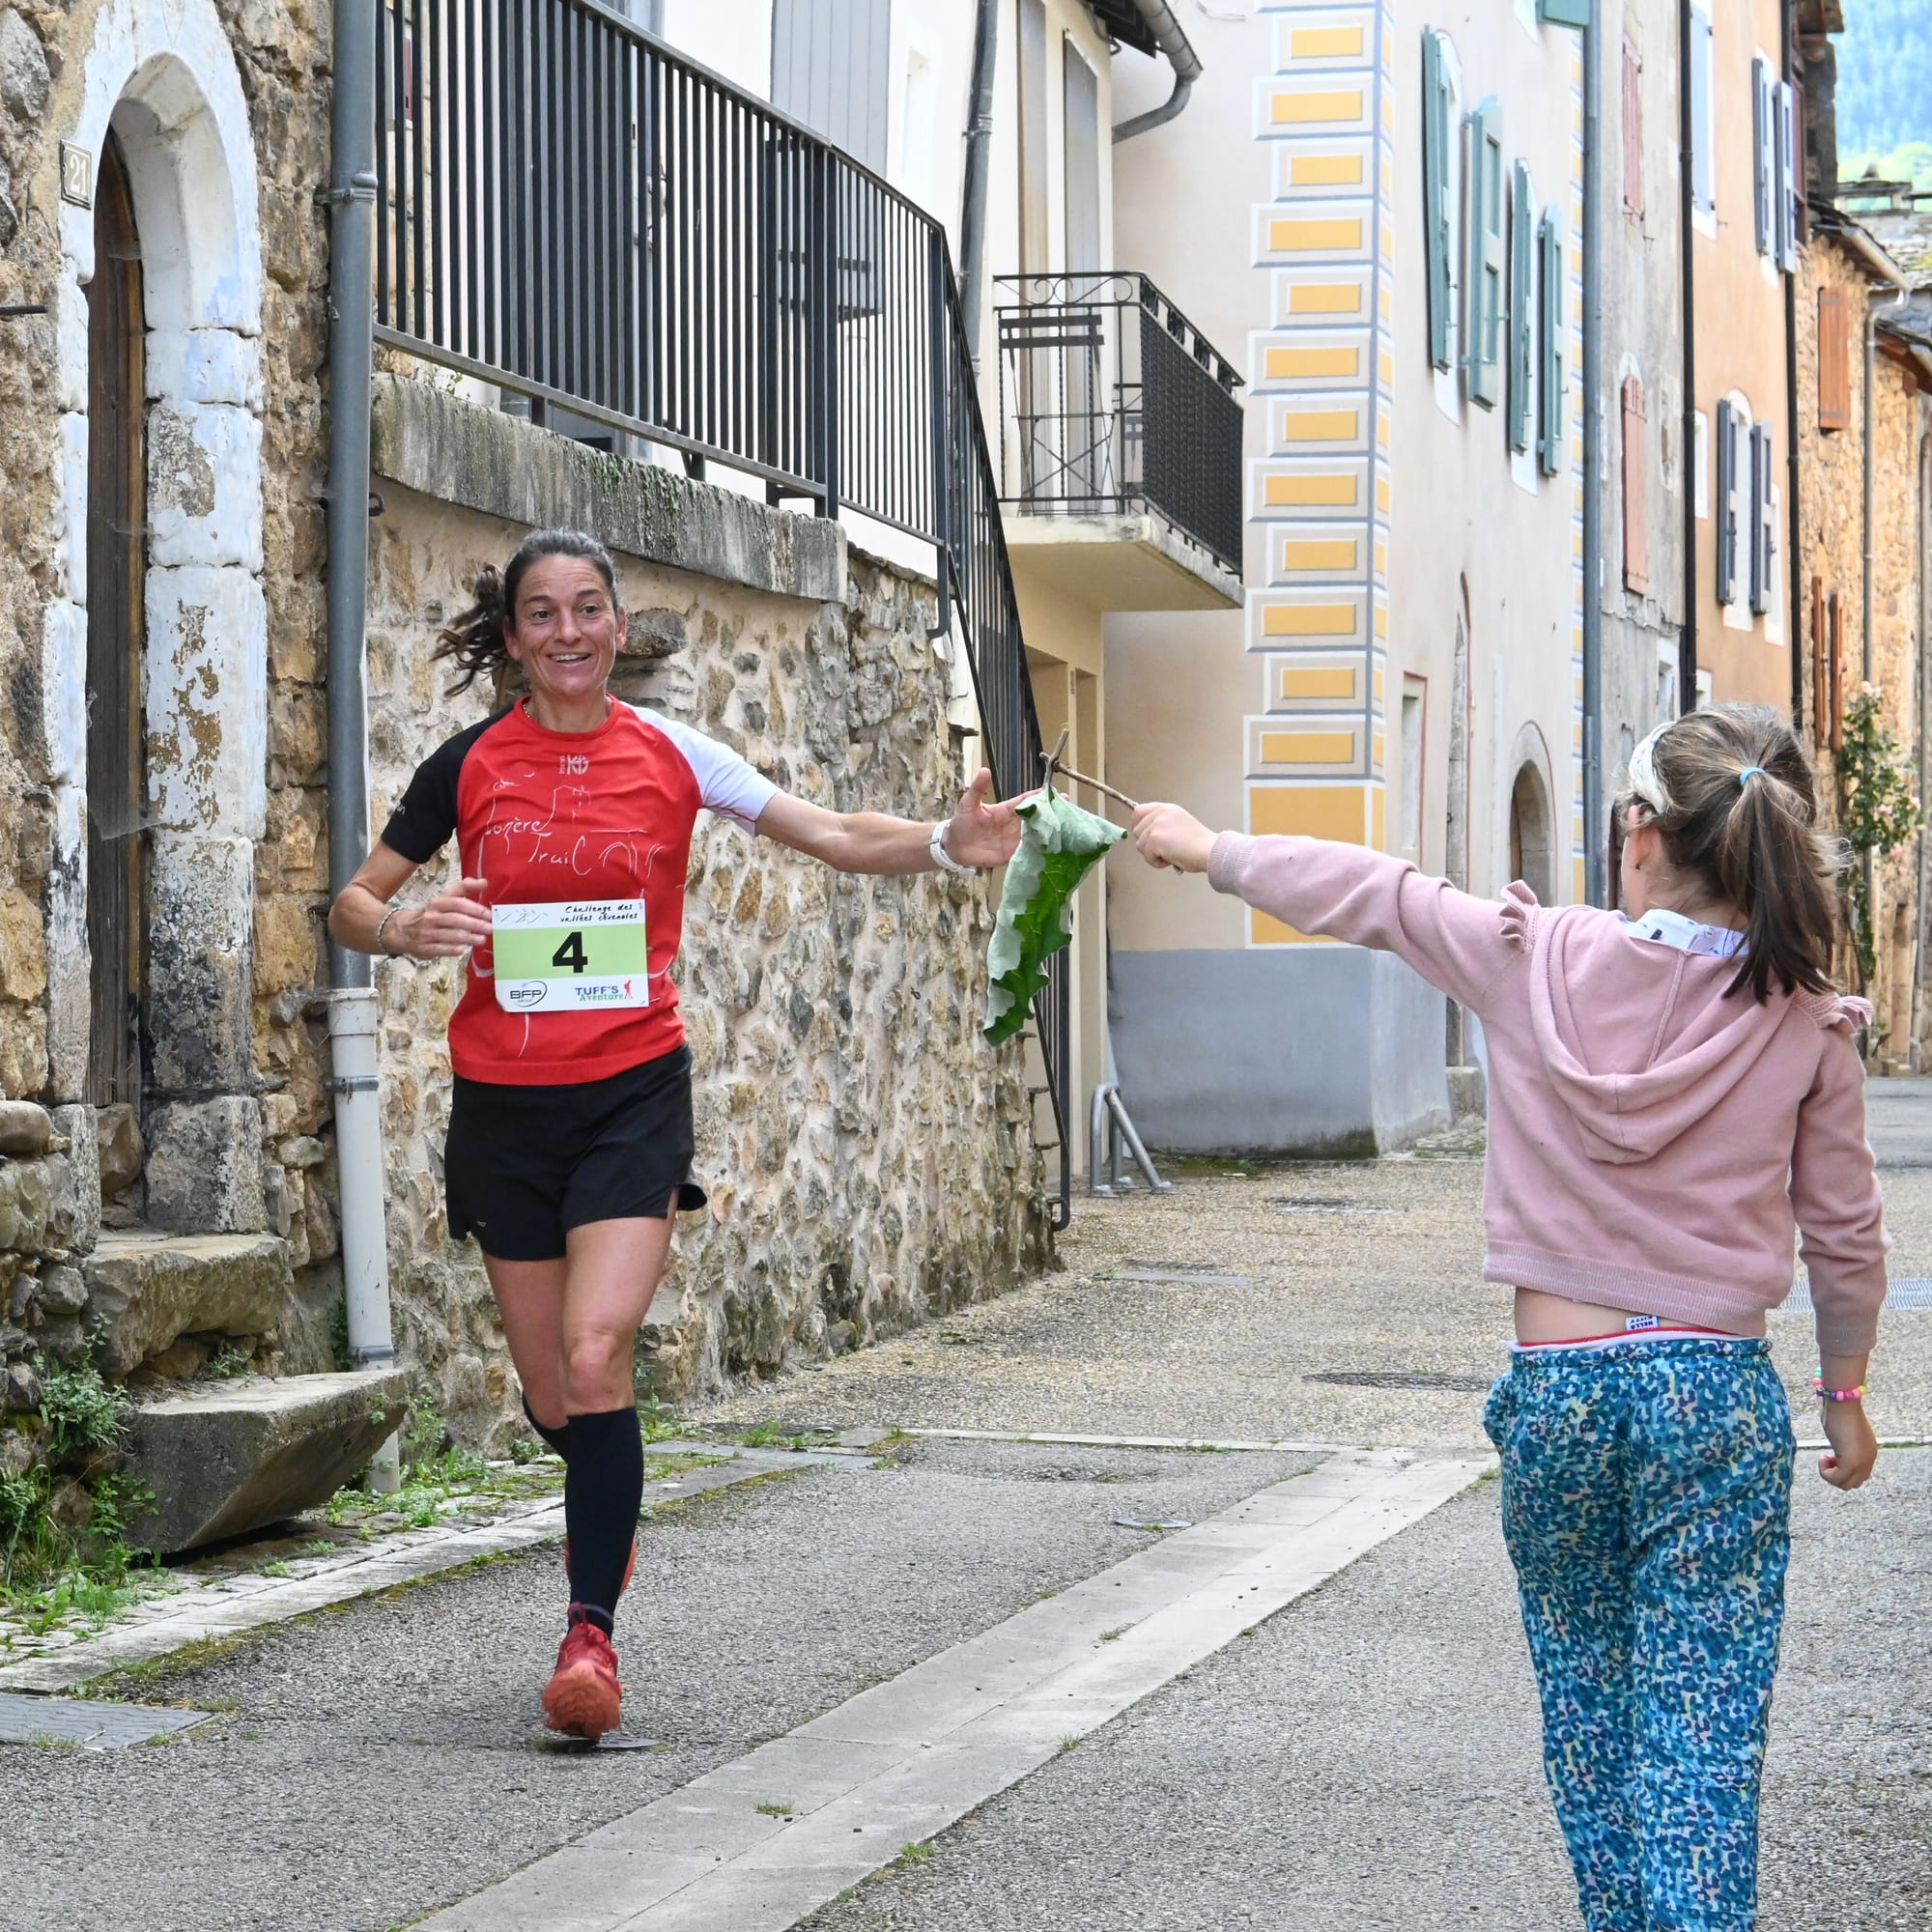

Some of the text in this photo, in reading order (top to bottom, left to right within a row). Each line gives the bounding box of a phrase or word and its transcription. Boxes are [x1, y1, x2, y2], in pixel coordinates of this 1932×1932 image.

[70, 154, 87, 196] 21
[528, 832, 592, 876] Trail
[565, 904, 611, 914] Challenge
[560, 914, 592, 923] vallées
[552, 931, 588, 974] 4
[510, 989, 542, 1000] BFP
[575, 985, 619, 996] TUFF'S
[1630, 1321, 1653, 1330] HELLO
